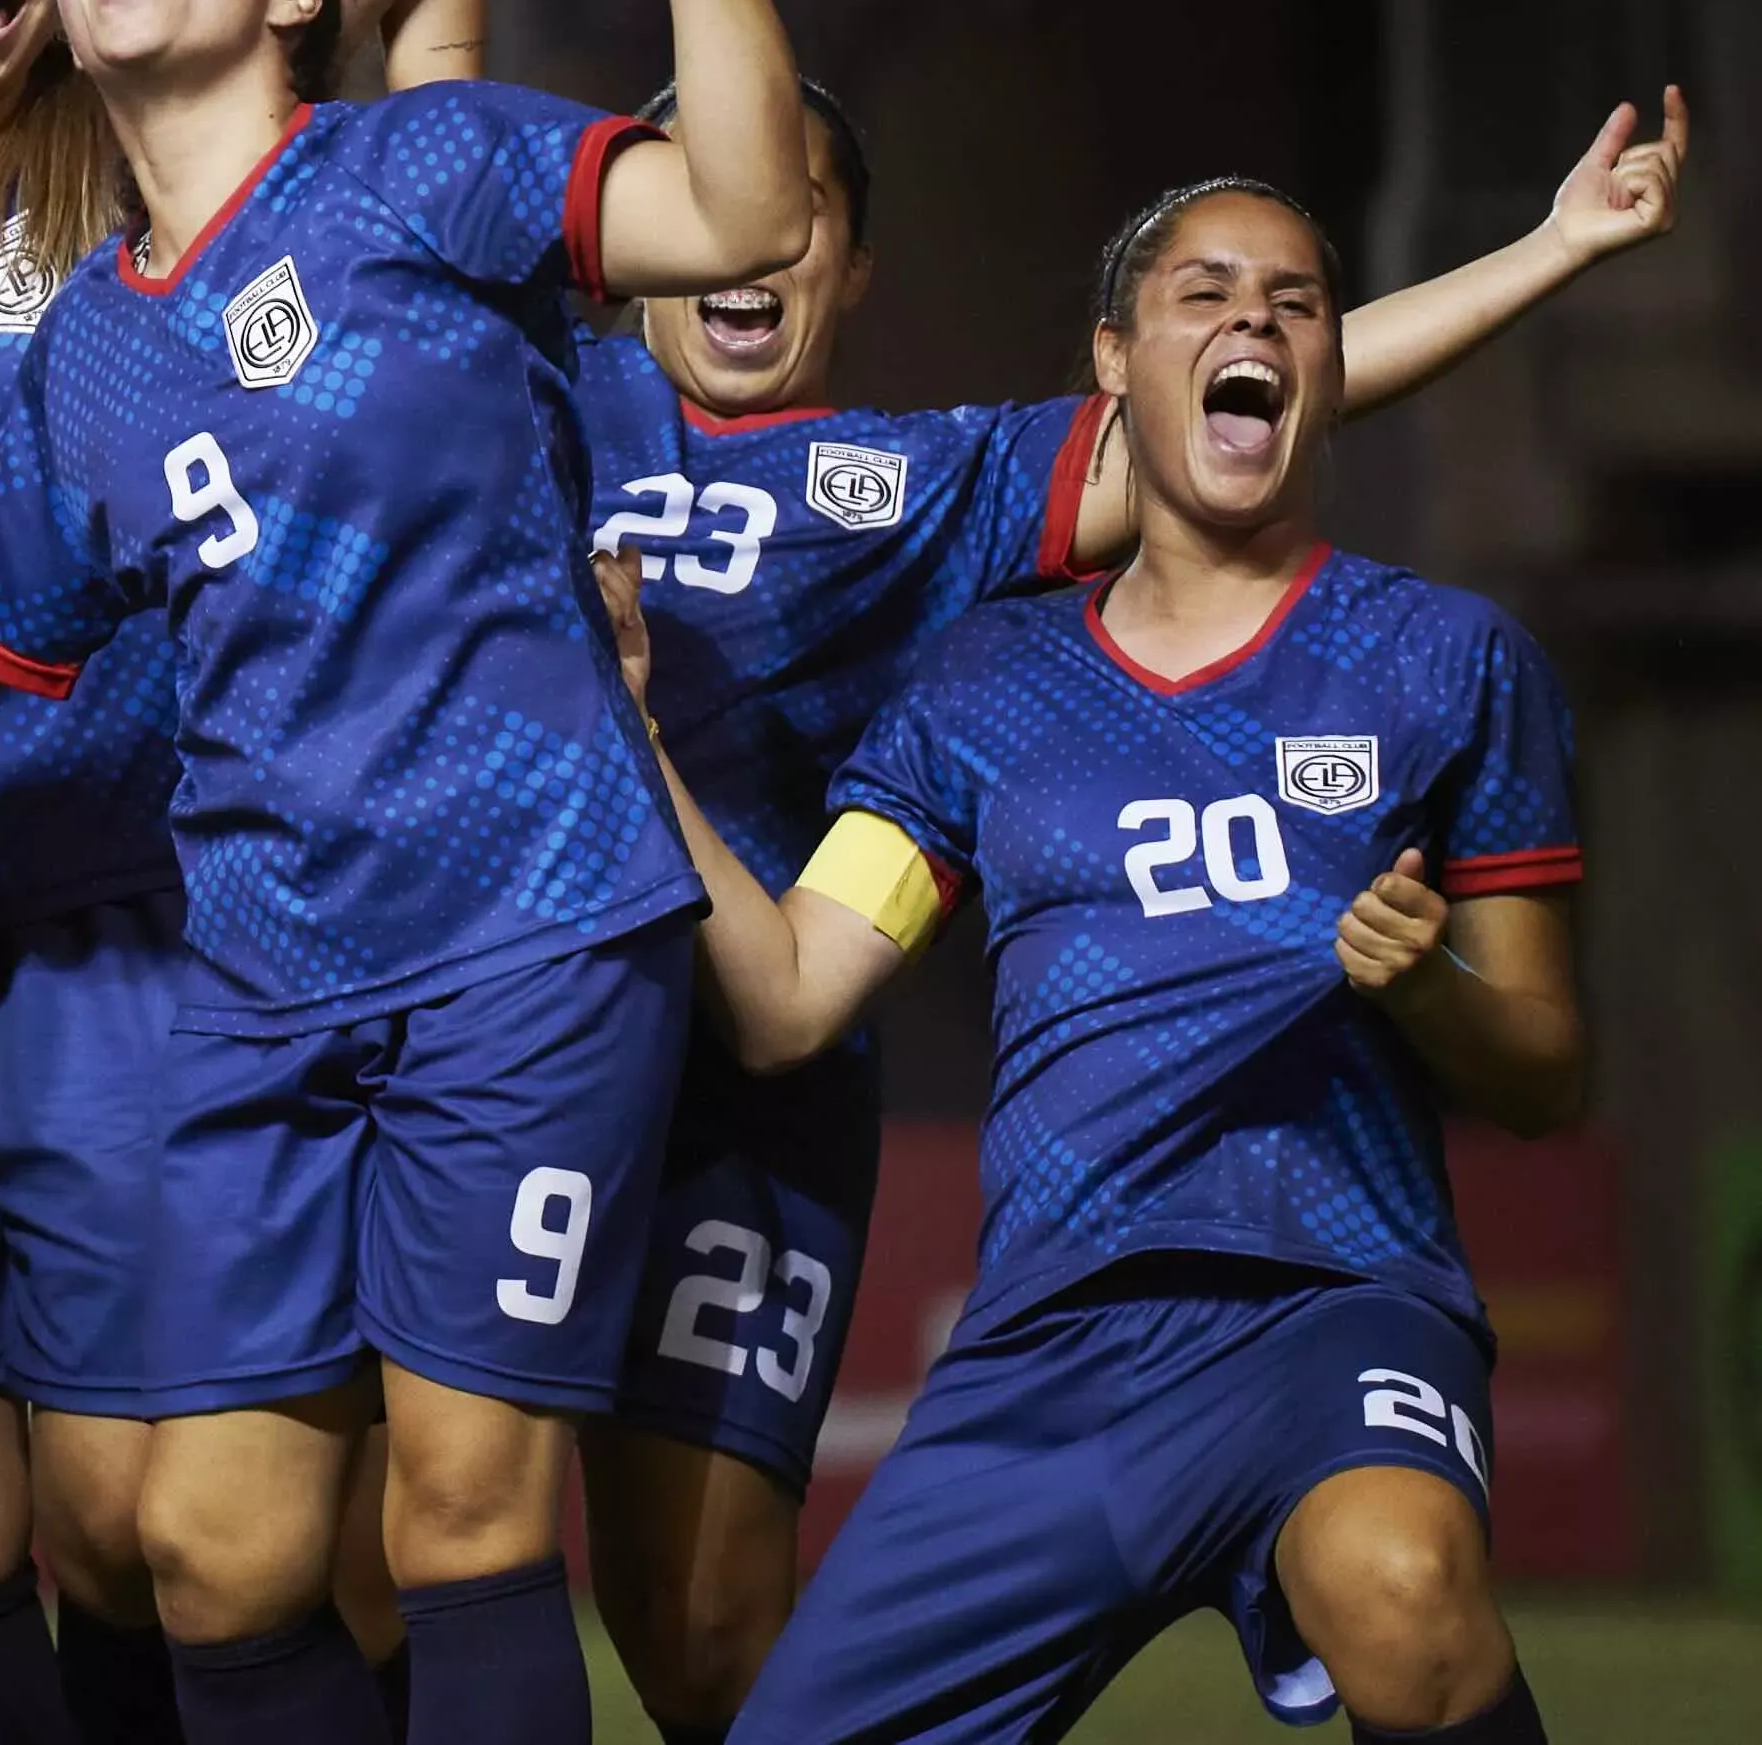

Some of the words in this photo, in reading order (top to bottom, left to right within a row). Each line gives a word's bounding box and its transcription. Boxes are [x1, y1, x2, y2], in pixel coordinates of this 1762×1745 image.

[163, 432, 259, 569] 9
[587, 472, 777, 595] 23
[1117, 794, 1291, 918] 20
[496, 1166, 593, 1325] 9
[657, 1220, 832, 1403] 23
